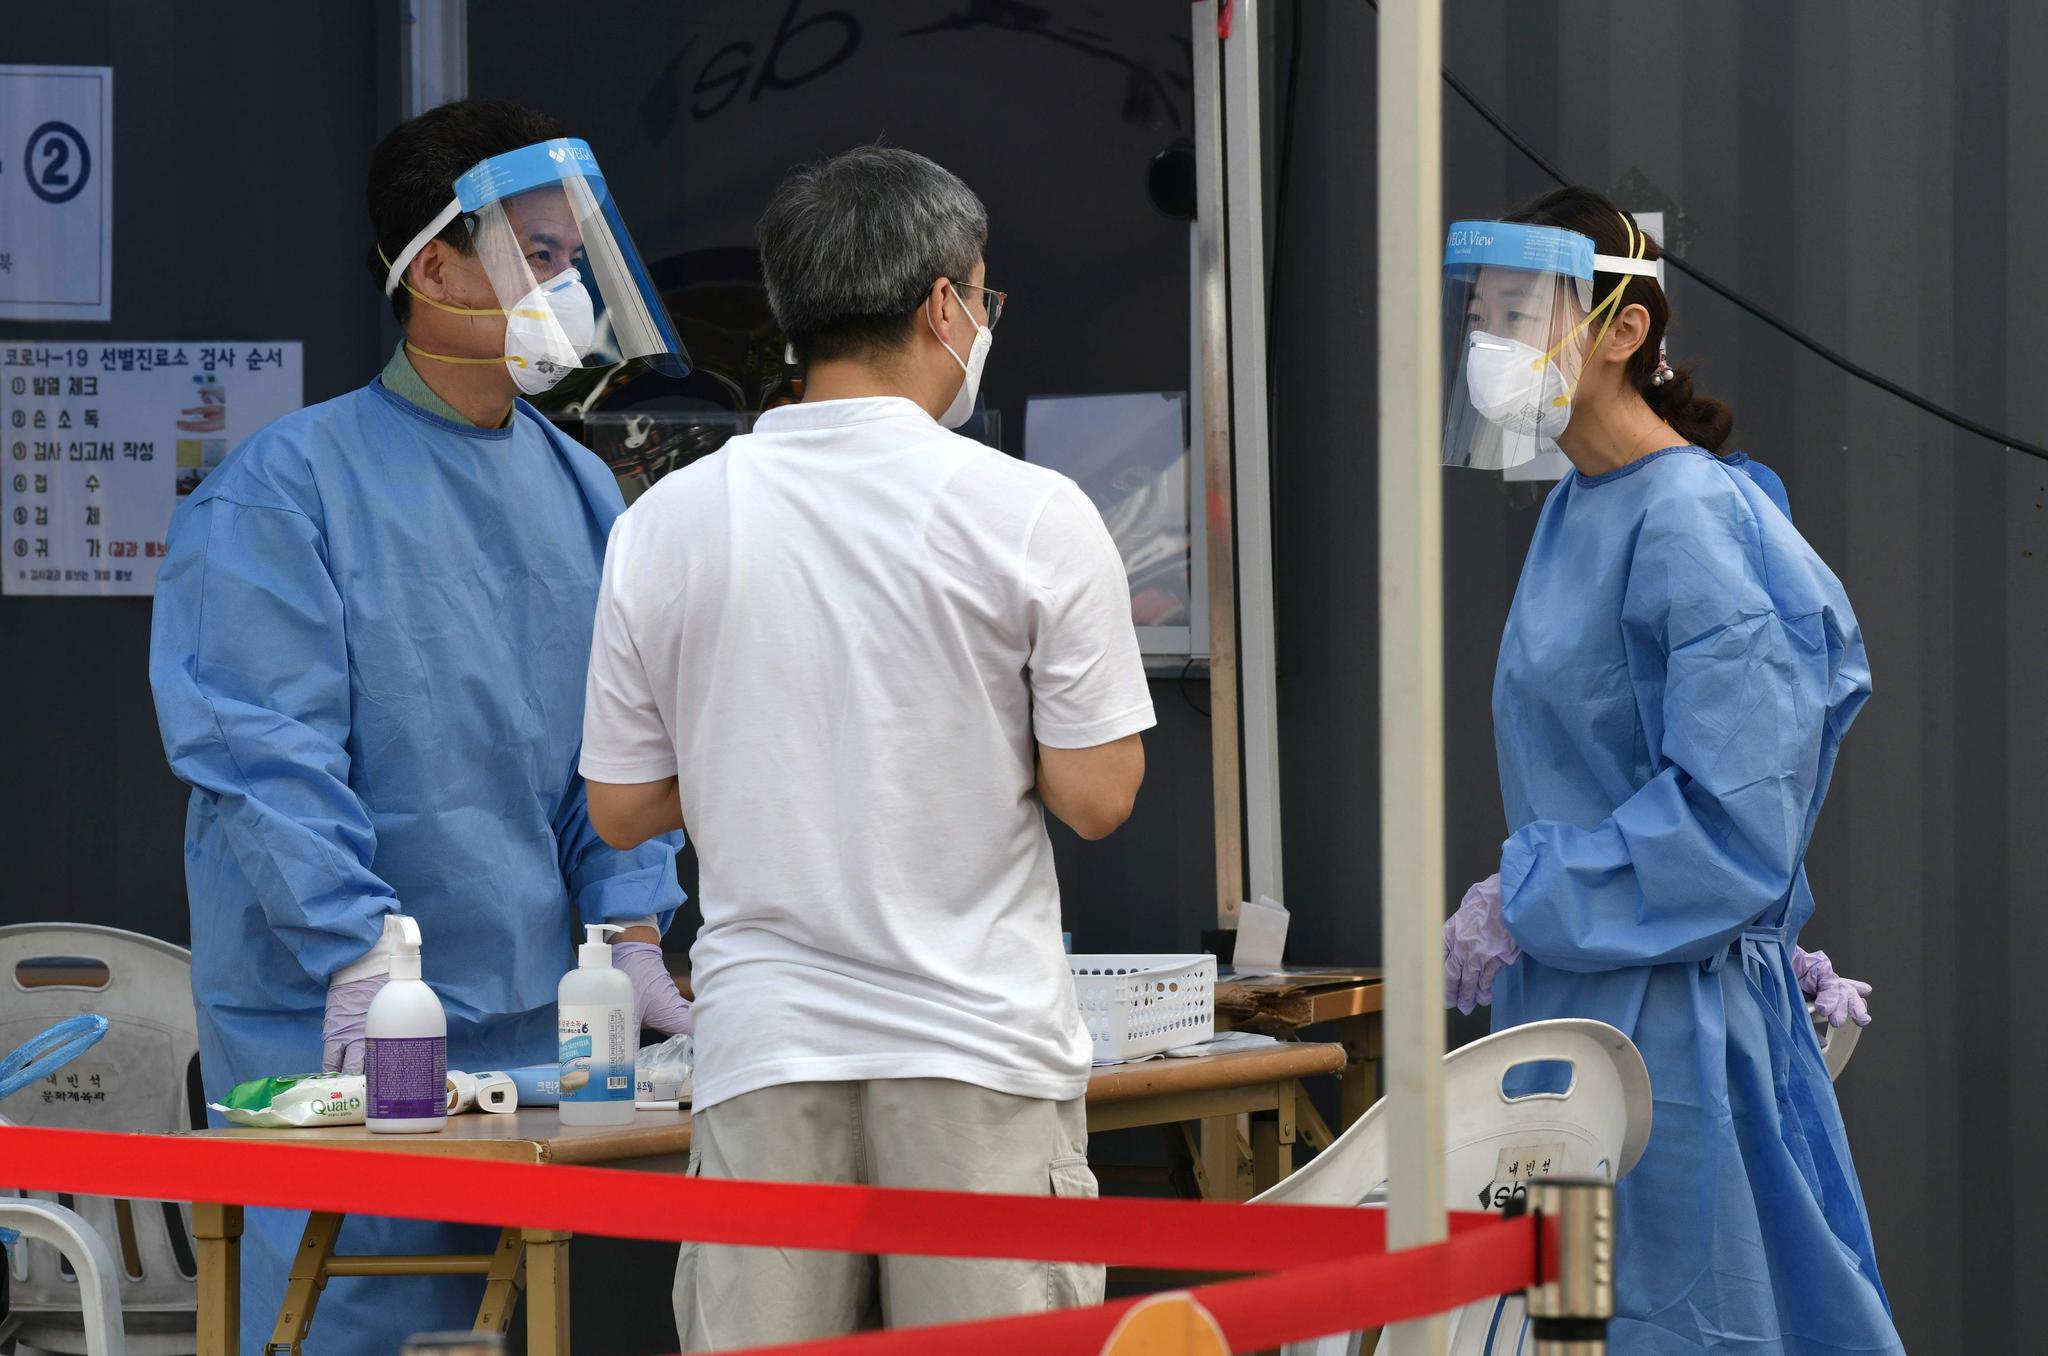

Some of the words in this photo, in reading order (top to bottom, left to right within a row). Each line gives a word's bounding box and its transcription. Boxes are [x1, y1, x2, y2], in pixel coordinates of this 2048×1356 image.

[1470, 231, 1494, 247] View
[4, 349, 88, 368] 코로나-19
[100, 348, 189, 371] 선별진료소
[200, 348, 235, 371] 검사
[246, 348, 283, 370] 순서
[33, 376, 60, 396] 발열
[68, 376, 98, 396] 체크
[33, 442, 61, 461] 검사
[69, 442, 115, 461] 신고서
[123, 442, 154, 461] 작성
[330, 1091, 343, 1099] 3M
